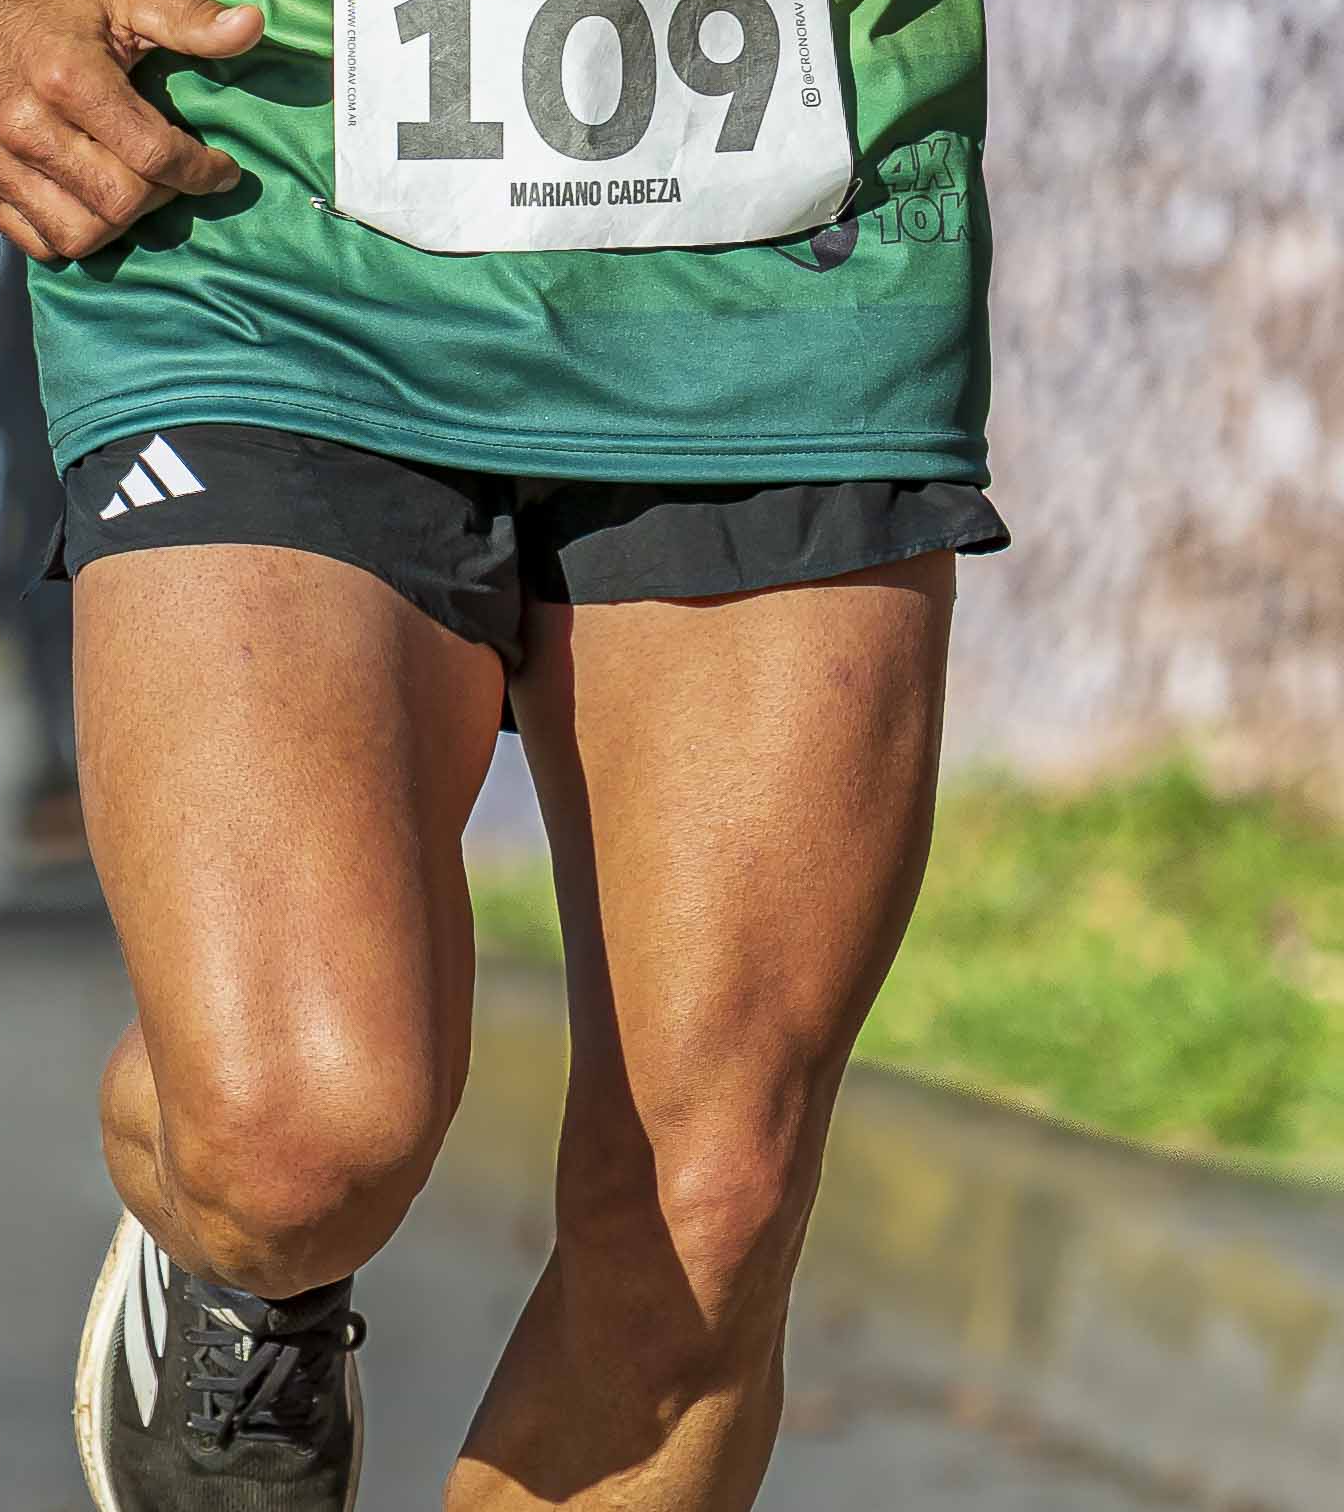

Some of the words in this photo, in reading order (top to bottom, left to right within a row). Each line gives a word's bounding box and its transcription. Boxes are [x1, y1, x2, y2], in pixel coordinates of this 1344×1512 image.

[794, 2, 815, 85] @CRONORAV
[510, 181, 602, 207] MARIANO
[607, 177, 682, 205] CABEZA
